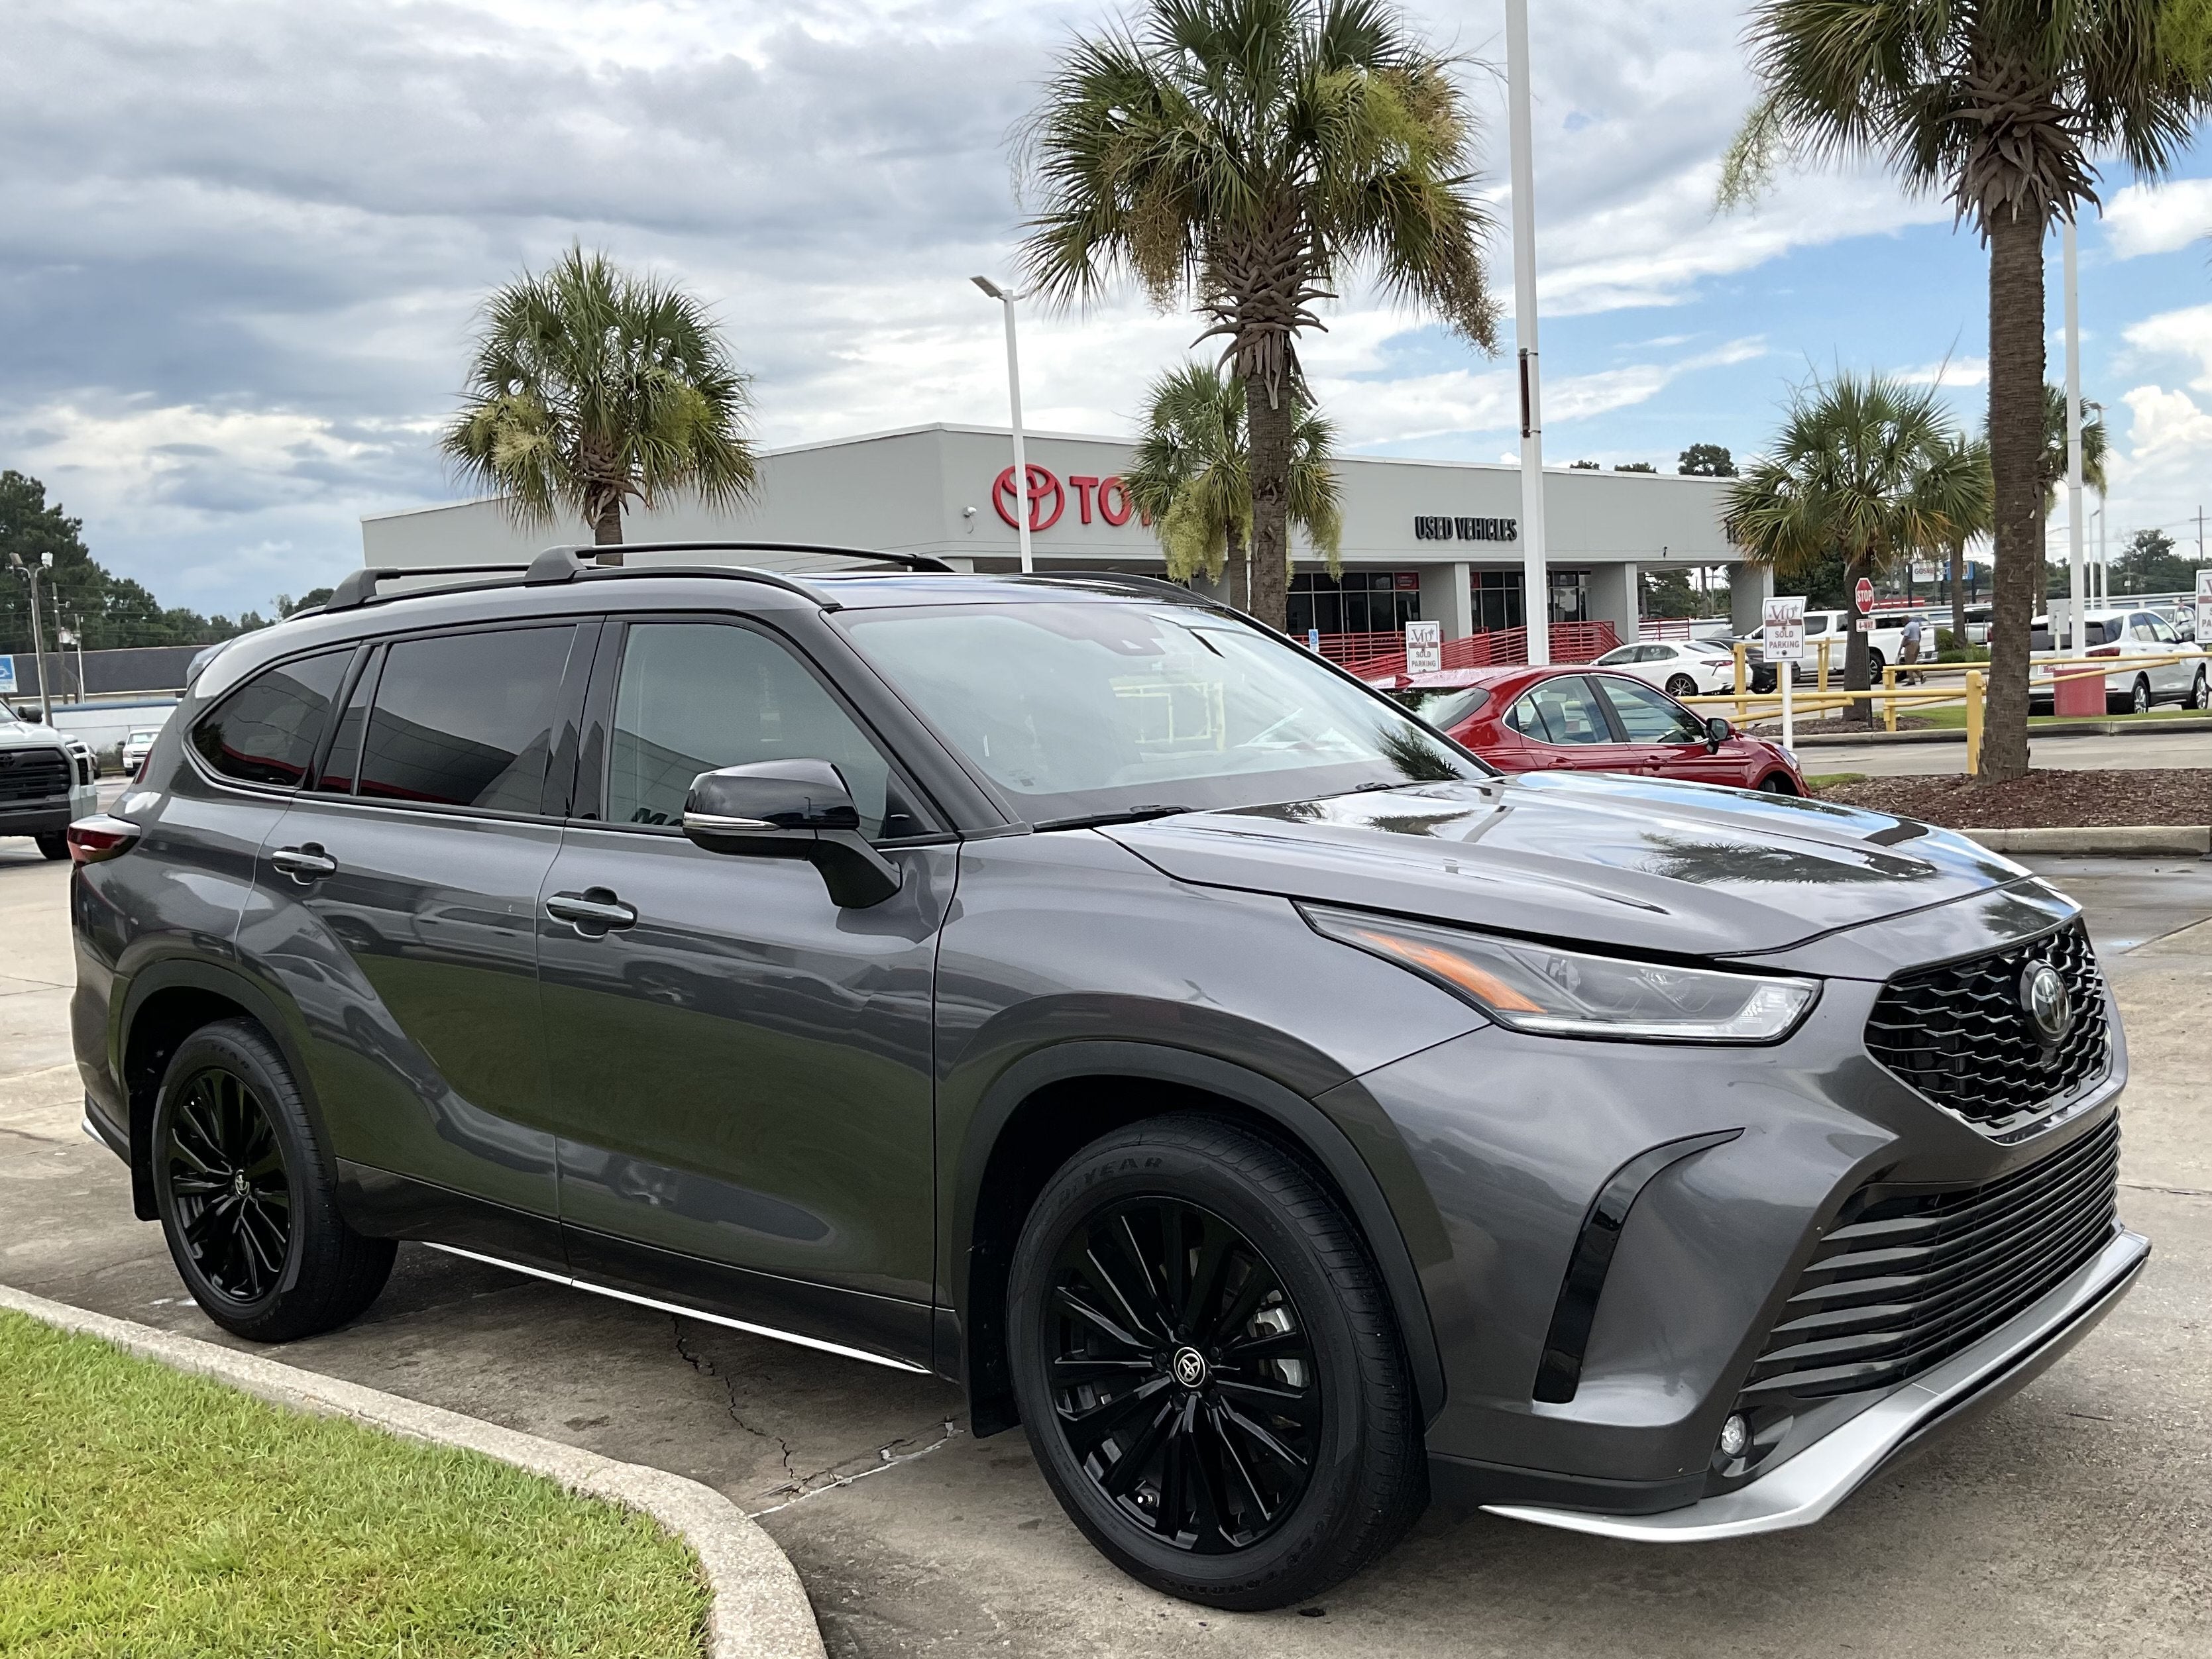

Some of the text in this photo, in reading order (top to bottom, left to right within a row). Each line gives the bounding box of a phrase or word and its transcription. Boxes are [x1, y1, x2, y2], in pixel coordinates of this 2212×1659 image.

[1415, 516, 1517, 541] USED VEHICLES
[1857, 590, 1872, 602] STOP
[1858, 621, 1873, 629] 4-WAY
